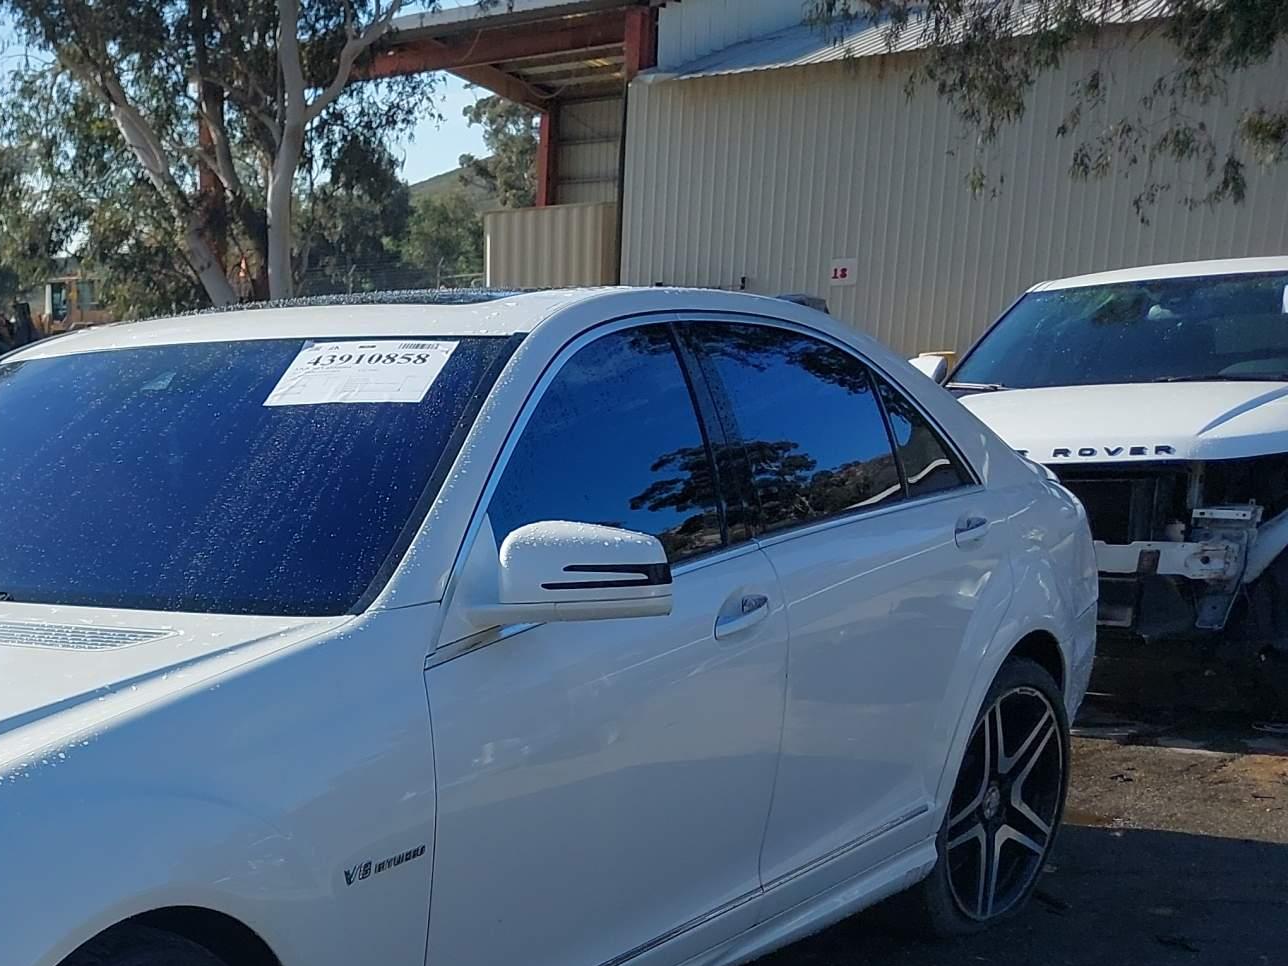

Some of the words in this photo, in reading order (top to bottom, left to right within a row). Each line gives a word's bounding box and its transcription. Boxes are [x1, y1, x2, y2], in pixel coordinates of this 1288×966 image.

[831, 267, 848, 280] 18
[307, 352, 431, 367] 43910858
[1052, 445, 1176, 458] ROVER
